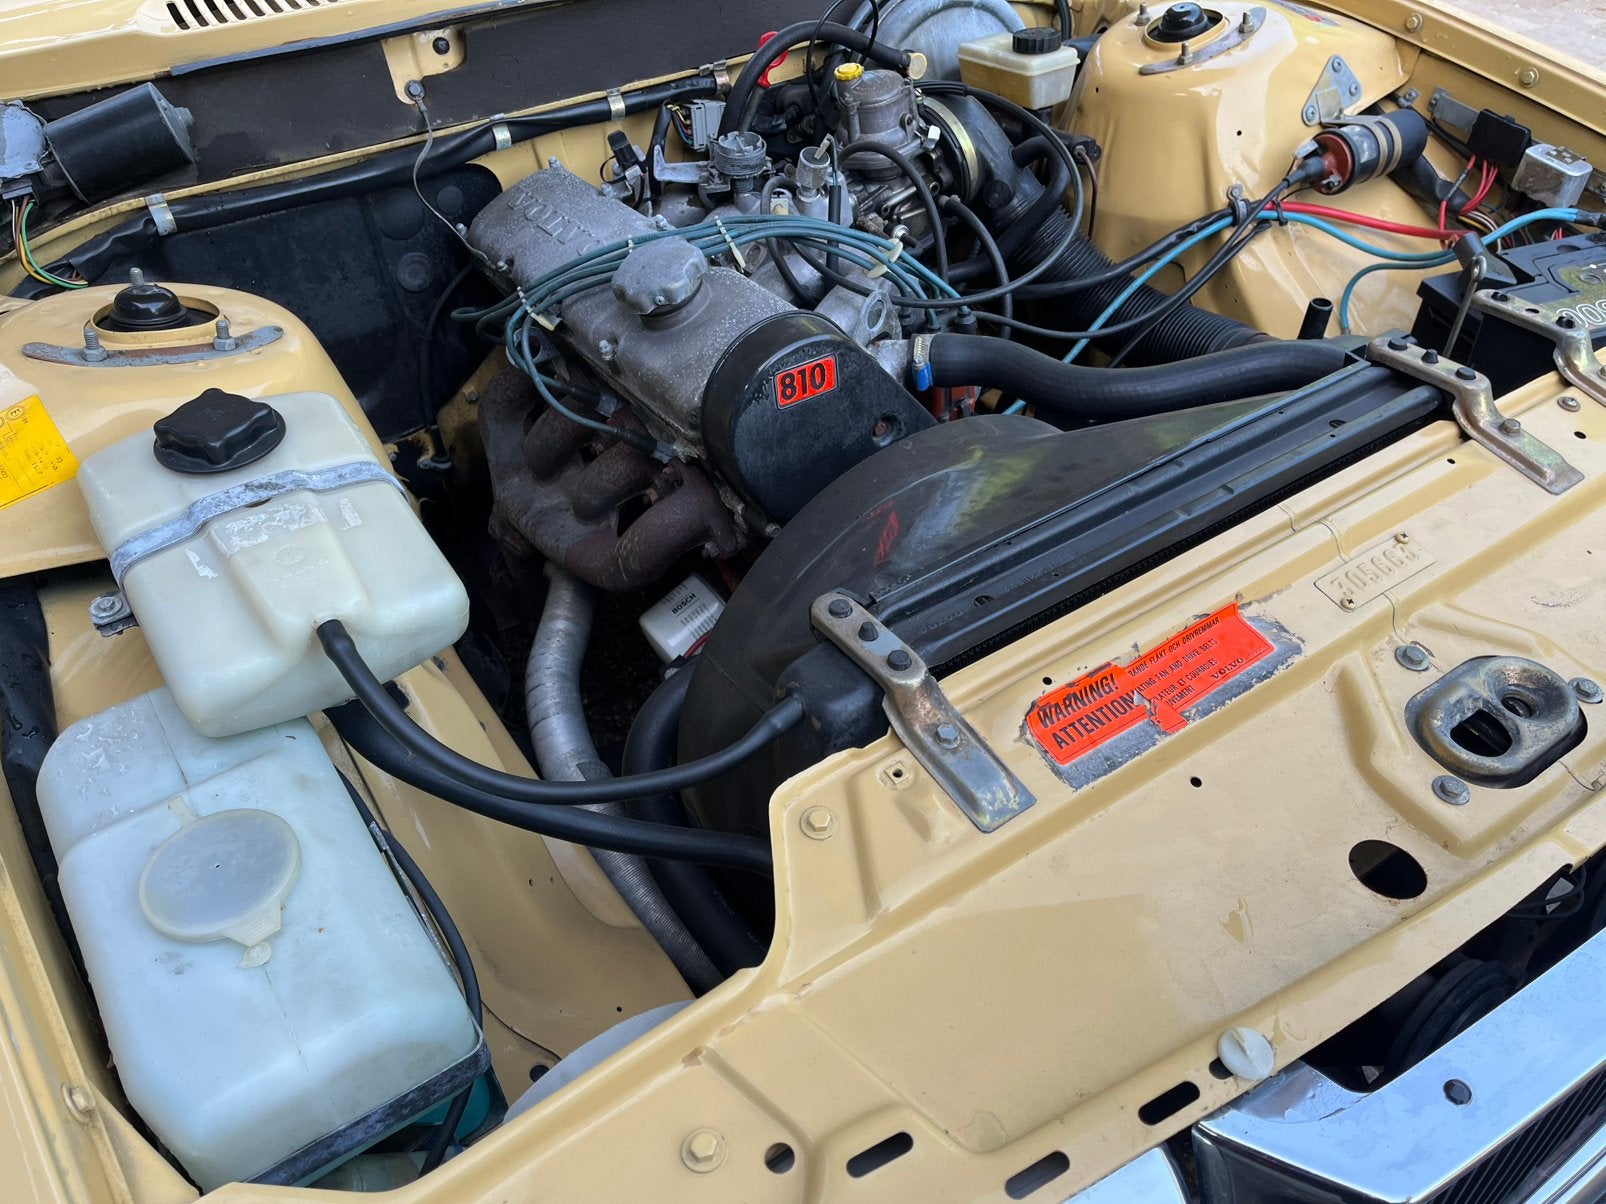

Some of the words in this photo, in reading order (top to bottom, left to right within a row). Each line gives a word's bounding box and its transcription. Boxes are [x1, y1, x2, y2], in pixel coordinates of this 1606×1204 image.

[780, 362, 826, 401] 810
[671, 593, 697, 615] BOSCH
[1168, 641, 1181, 653] OCH
[1182, 616, 1220, 645] DRIVREMMAR
[1153, 685, 1178, 701] LATEUR
[1177, 678, 1186, 687] ET
[1186, 658, 1218, 681] COURROIES
[1155, 670, 1169, 681] FAN
[1169, 661, 1183, 672] AND
[1182, 649, 1201, 663] DRIVE
[1199, 638, 1218, 652] BELTS
[1210, 657, 1244, 679] VOLVO
[1037, 673, 1119, 729] WARNING!
[1051, 690, 1136, 750] ATTENTION
